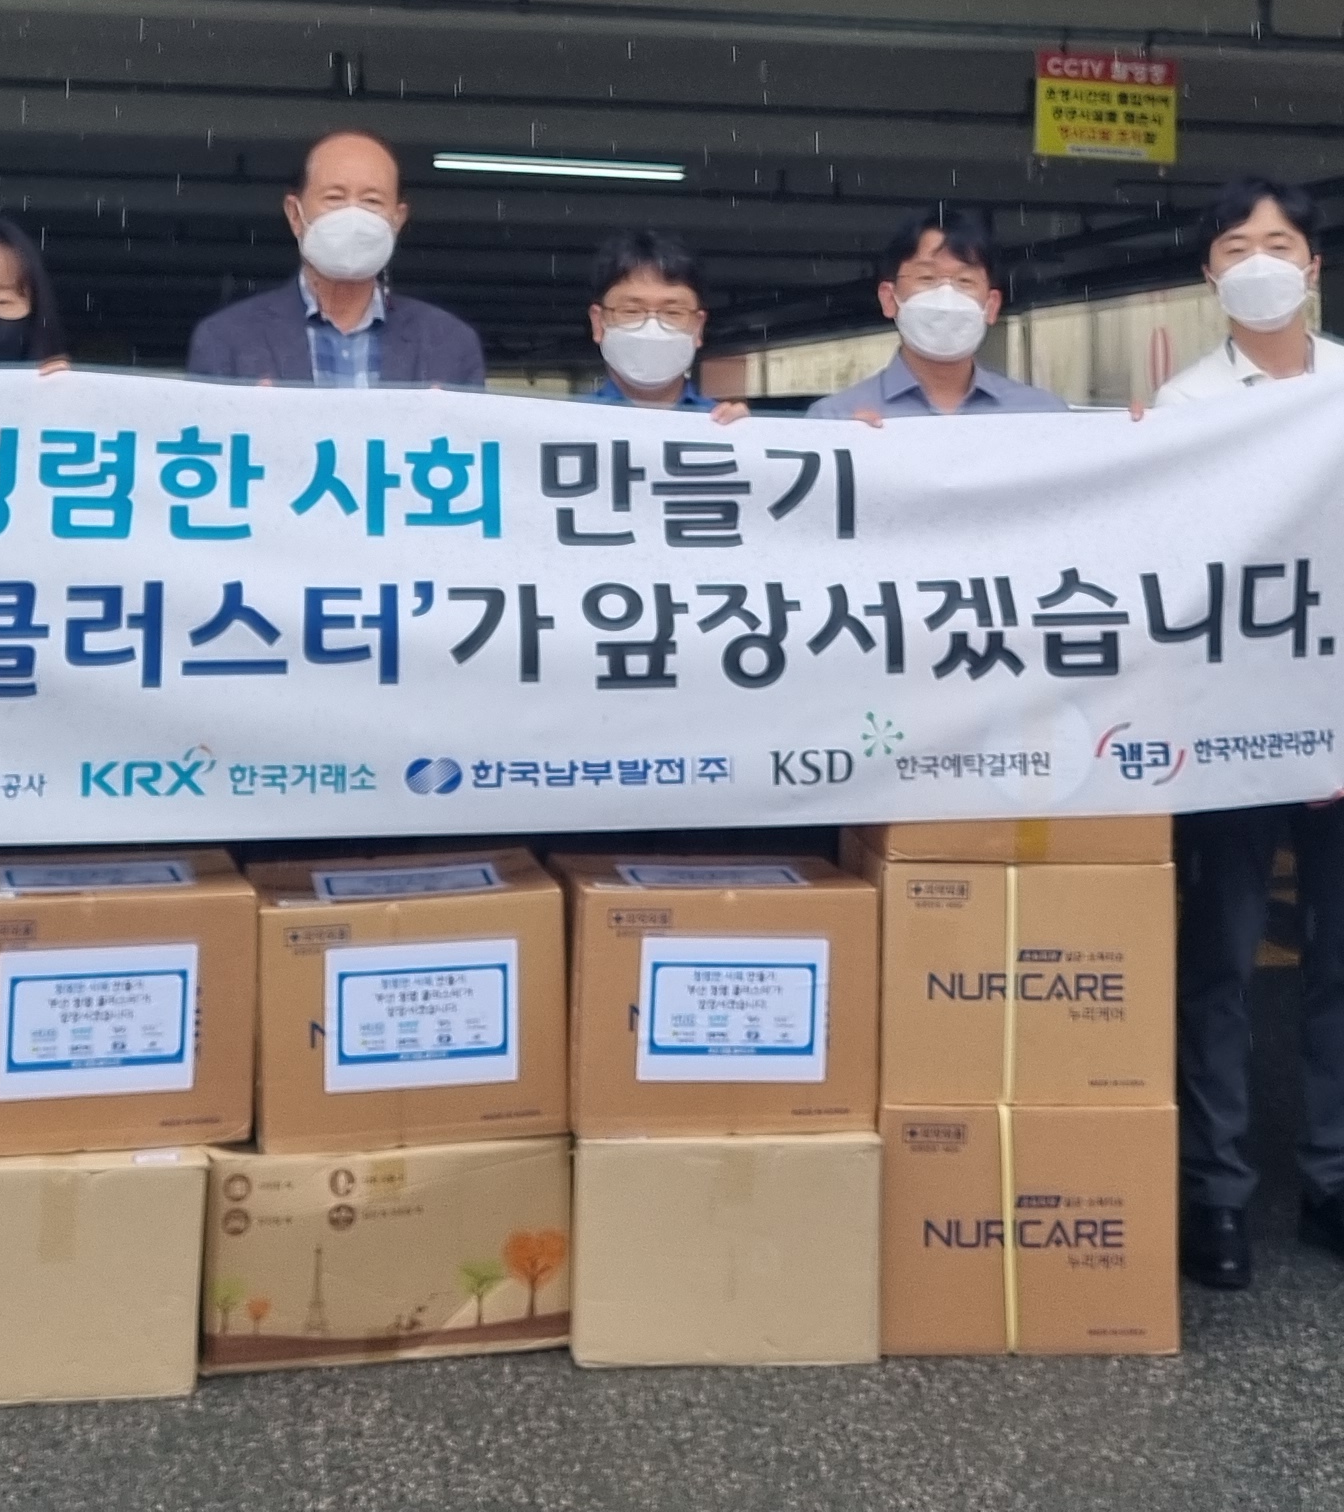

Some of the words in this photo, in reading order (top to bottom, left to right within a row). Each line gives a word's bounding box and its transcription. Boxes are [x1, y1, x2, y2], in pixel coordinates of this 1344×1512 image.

[1046, 56, 1106, 79] CCTV
[290, 437, 502, 538] 사회
[541, 439, 857, 549] 만들기
[581, 557, 1335, 691] 앞장서겠습니다.
[1111, 740, 1171, 780] 캠코
[1193, 729, 1335, 765] 한국자산관리공사
[80, 760, 211, 797] KRX
[228, 763, 378, 795] 한국거래소
[770, 749, 854, 786] KSD
[896, 751, 1050, 781] 한국예탁결제원
[927, 972, 1123, 1001] NURICARE
